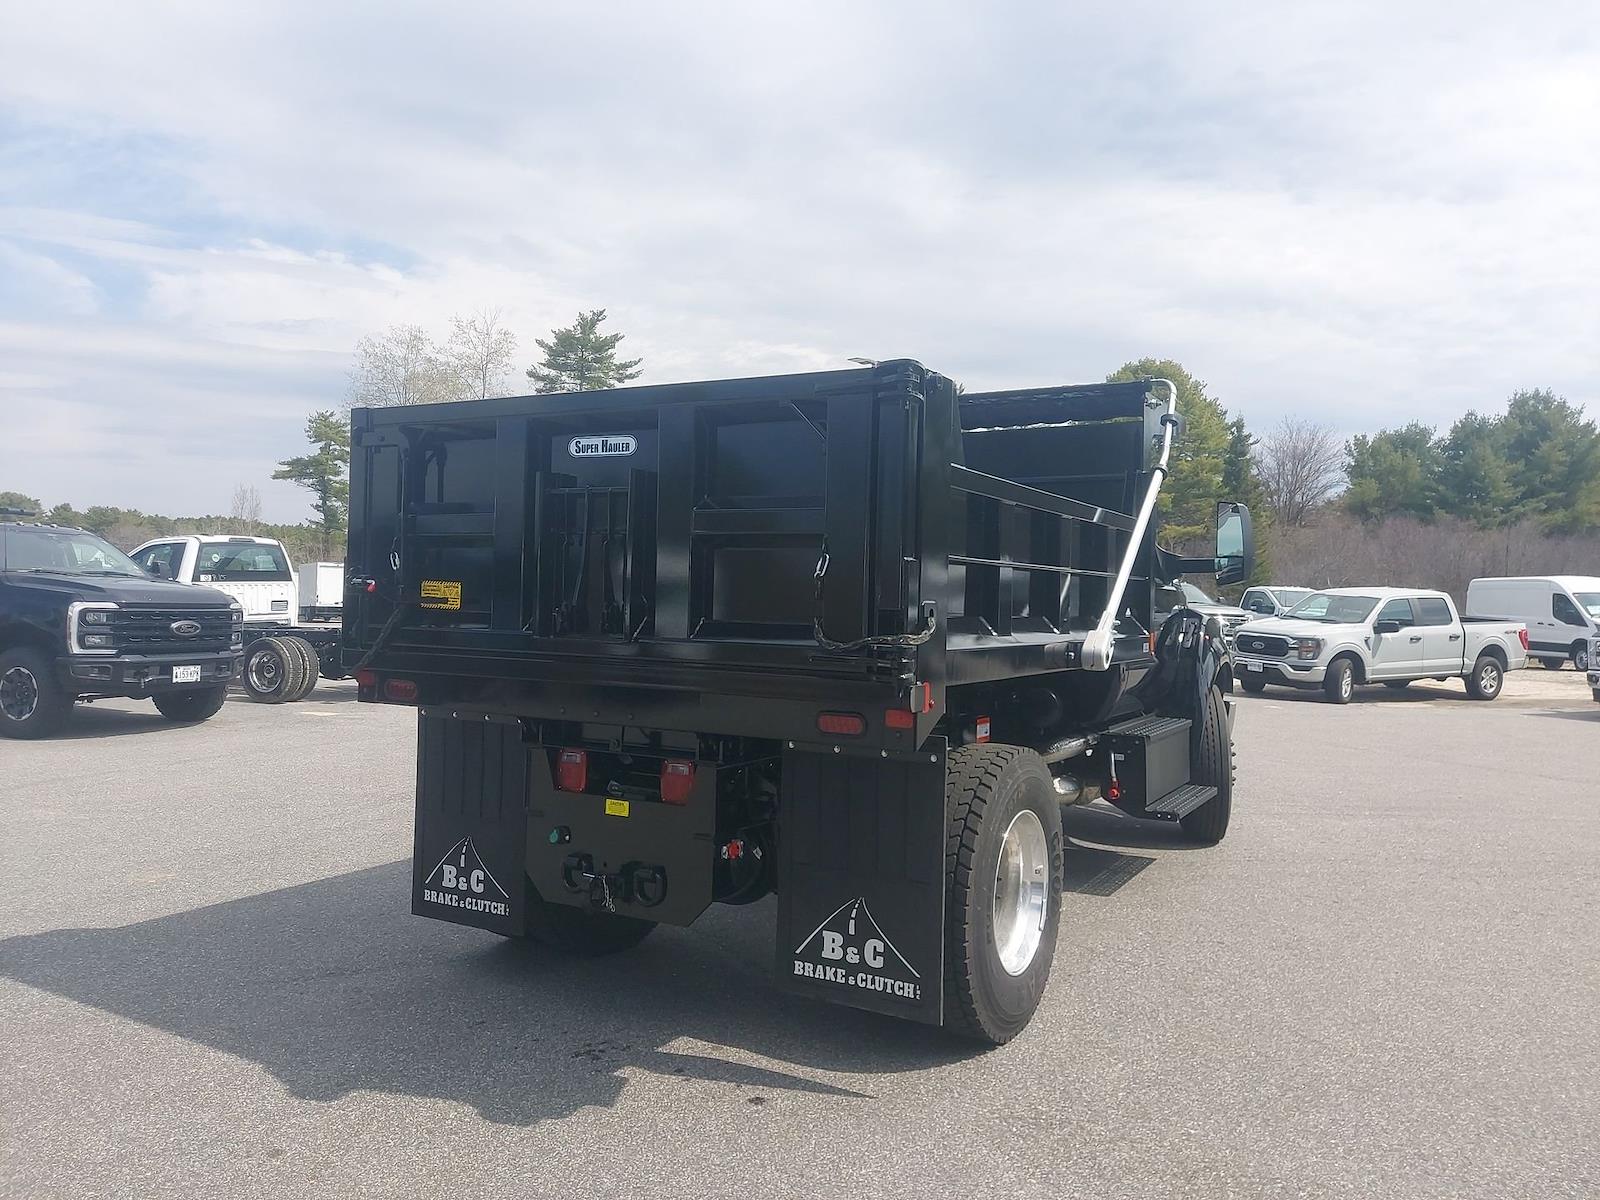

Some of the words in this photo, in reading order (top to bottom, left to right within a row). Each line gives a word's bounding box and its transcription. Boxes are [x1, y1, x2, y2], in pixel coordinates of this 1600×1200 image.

[575, 440, 599, 454] SUPER
[601, 439, 630, 453] HAULER
[424, 889, 458, 907] BRAKE
[465, 897, 505, 915] CLUTCH
[793, 960, 846, 984] BRAKE
[856, 972, 914, 998] CLUTCH
